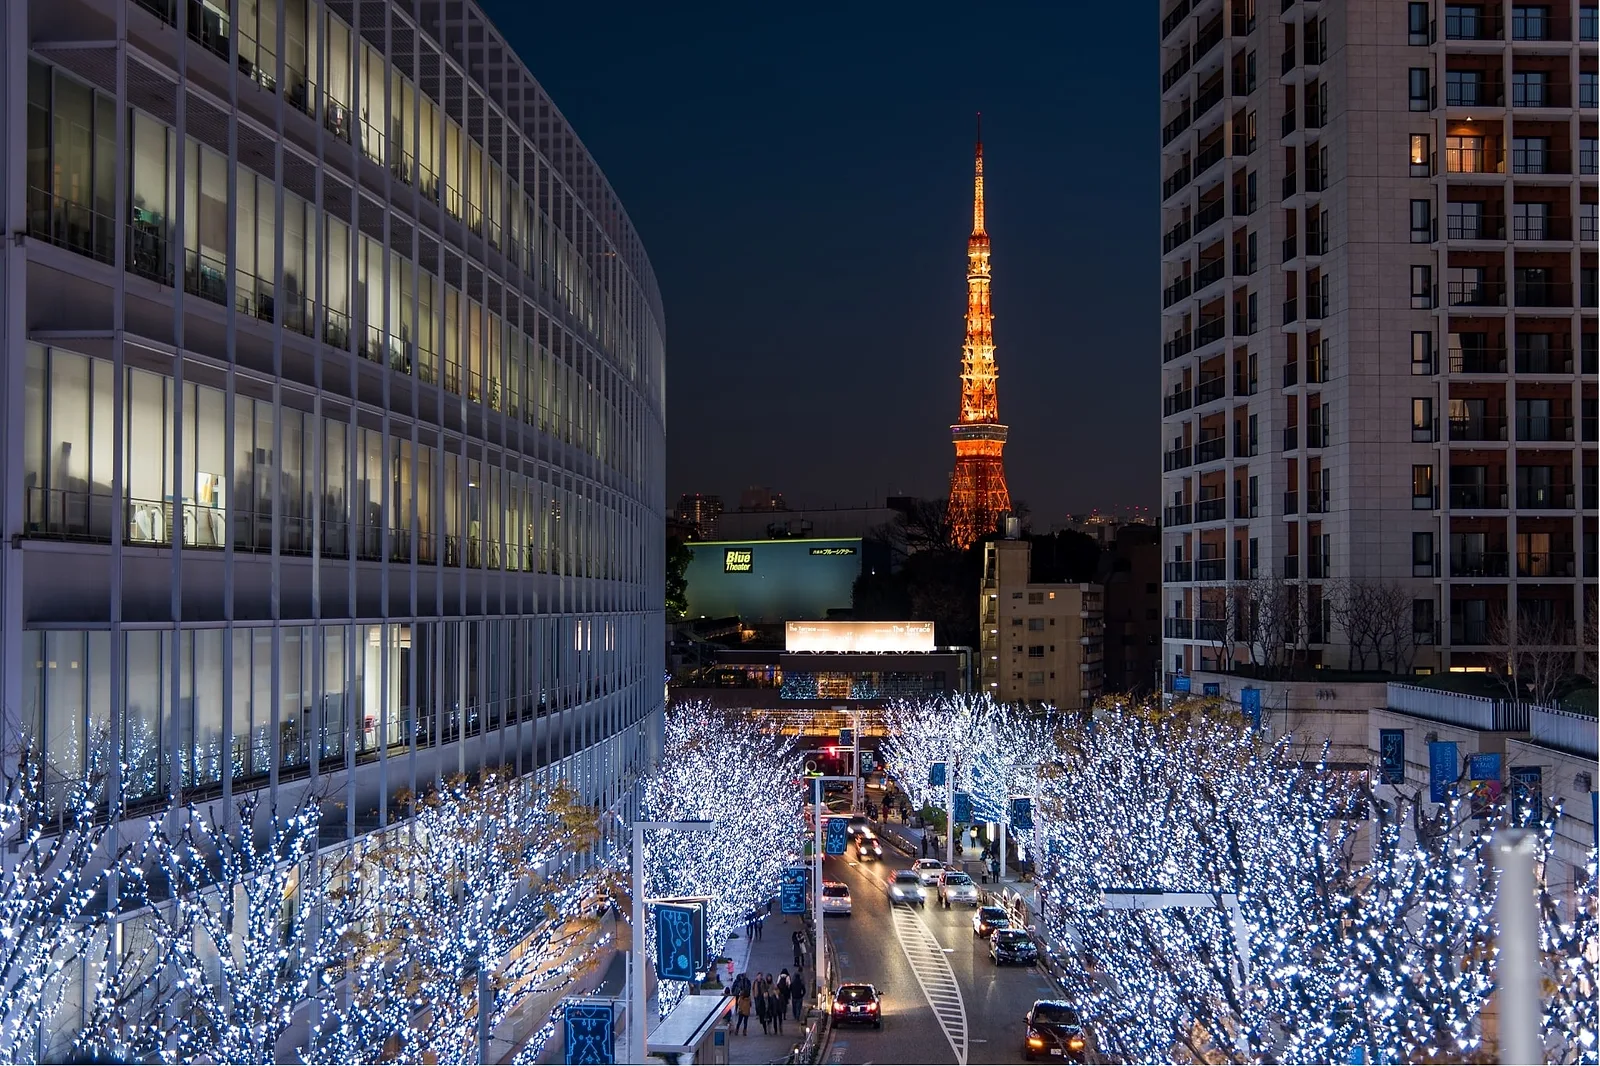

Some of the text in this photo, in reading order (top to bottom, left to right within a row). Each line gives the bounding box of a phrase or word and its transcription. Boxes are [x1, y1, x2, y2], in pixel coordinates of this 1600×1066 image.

[726, 551, 751, 563] Blue
[726, 563, 751, 571] Theater
[893, 625, 905, 633] The
[906, 625, 931, 633] Terrace
[1444, 746, 1452, 772] MERRY
[1435, 763, 1444, 797] GALAXY
